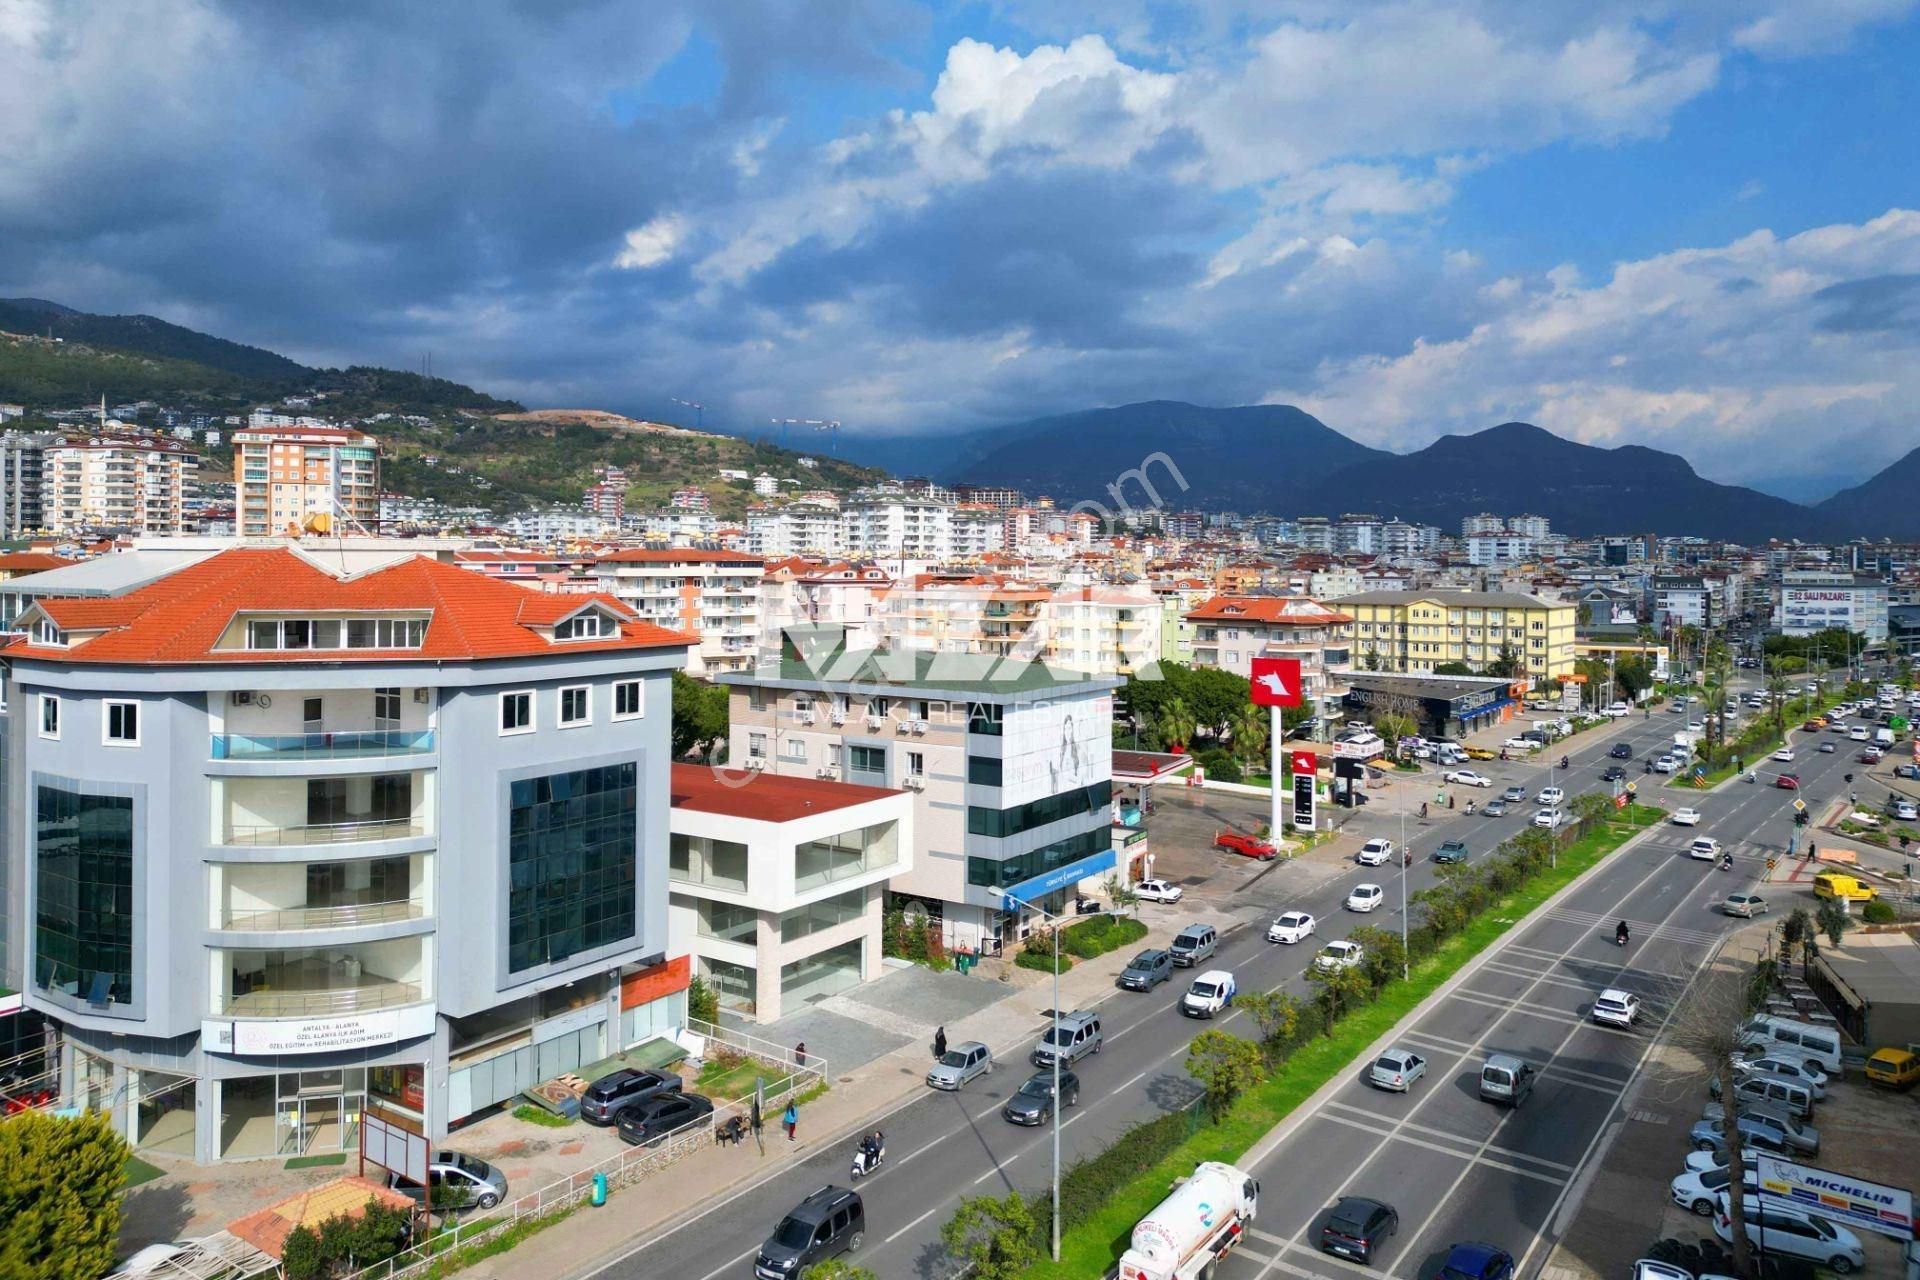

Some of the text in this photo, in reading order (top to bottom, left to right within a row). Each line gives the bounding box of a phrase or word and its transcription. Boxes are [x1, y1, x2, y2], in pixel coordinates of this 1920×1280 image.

[1350, 690, 1420, 710] ENGLISH HOME
[303, 1024, 330, 1032] ANTALYA
[335, 1022, 359, 1030] ALANYA
[313, 1031, 337, 1039] ALANYA
[1805, 1176, 1894, 1206] MICHELIN
